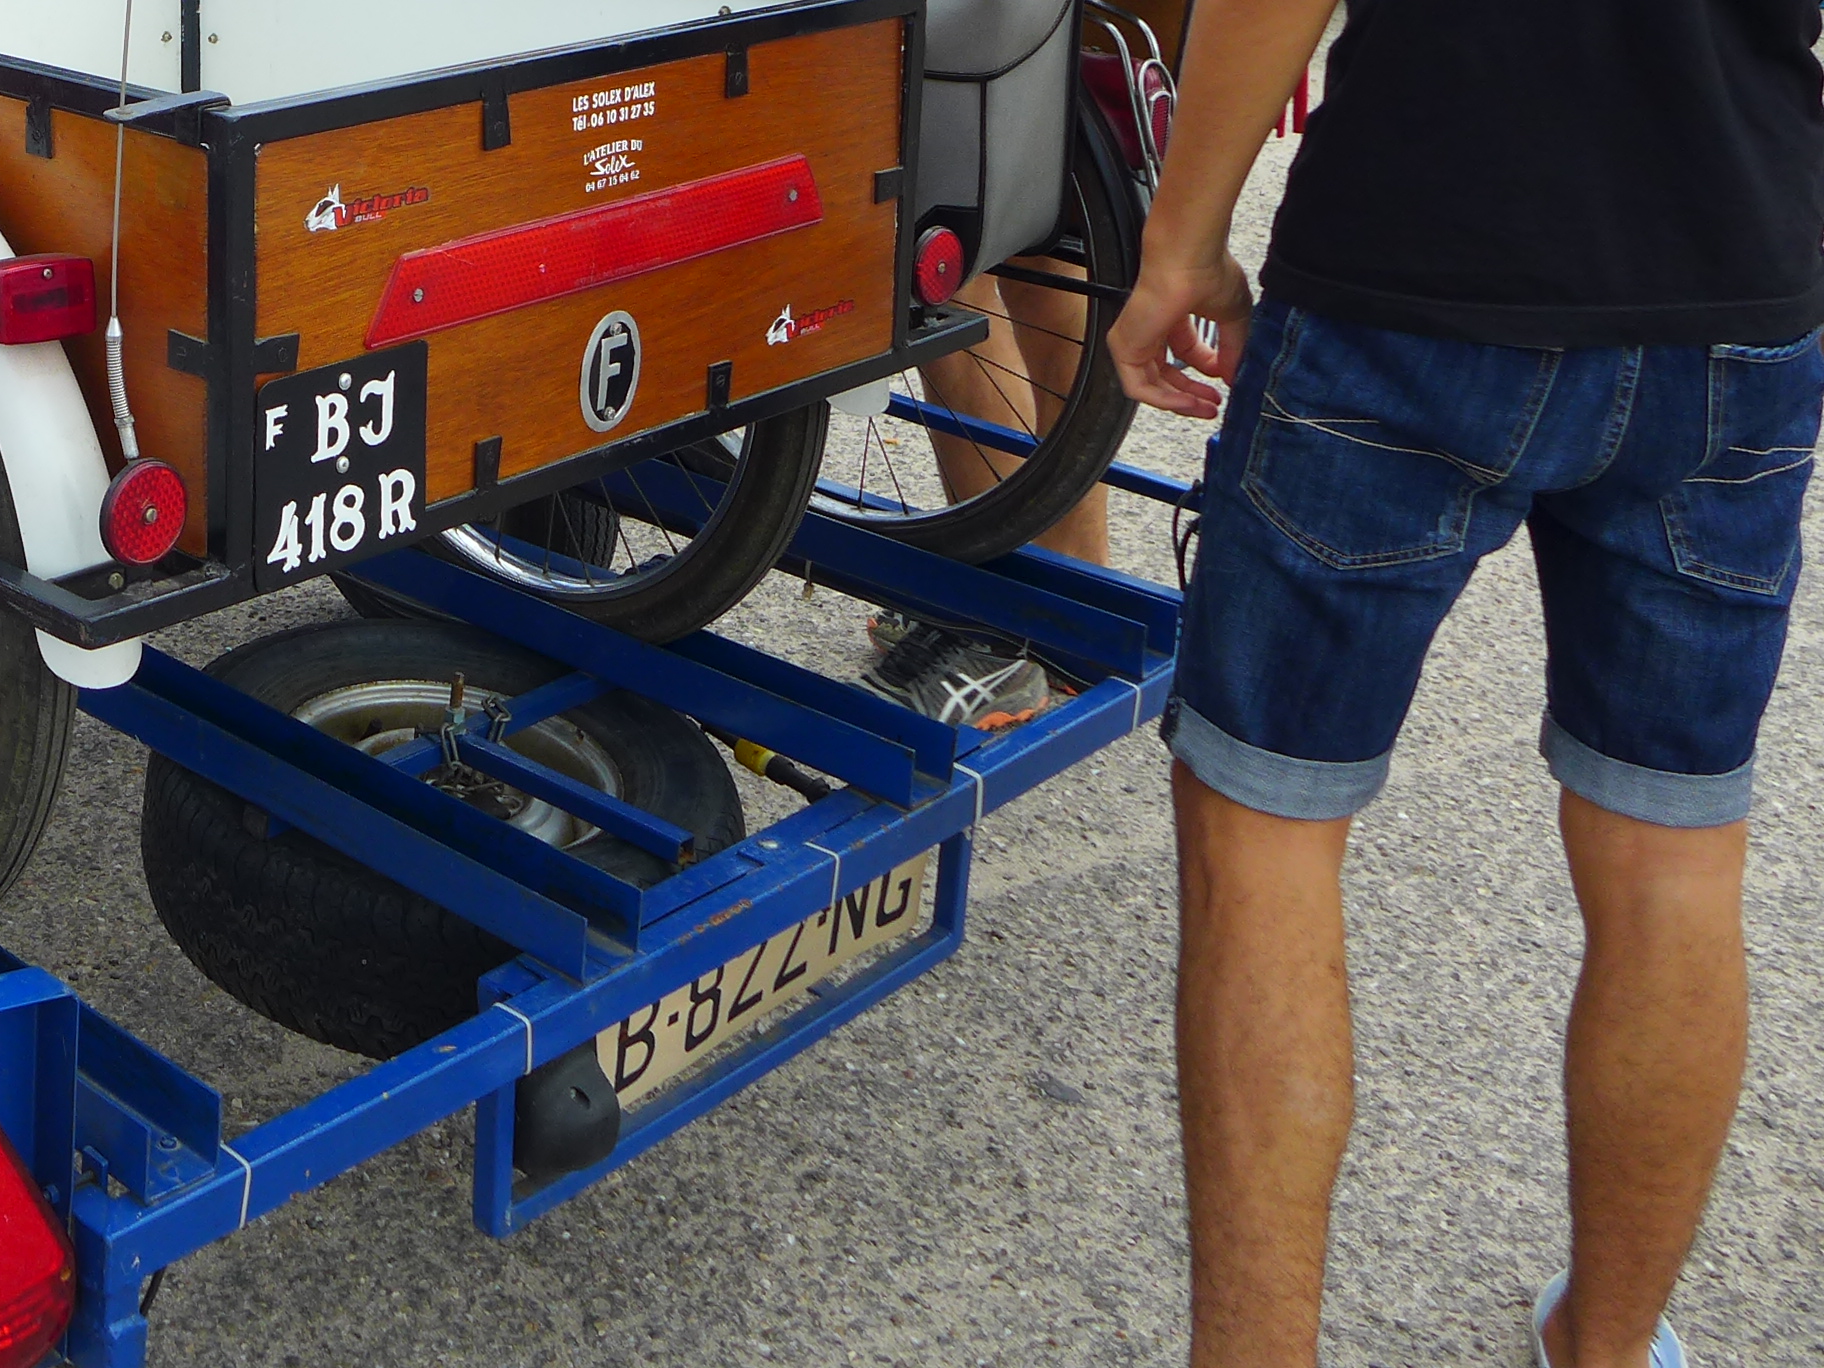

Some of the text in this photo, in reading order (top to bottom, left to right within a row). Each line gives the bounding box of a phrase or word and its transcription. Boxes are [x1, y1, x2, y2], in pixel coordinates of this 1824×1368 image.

[572, 80, 656, 113] LES SOLEX D'ALEX
[606, 109, 617, 124] 10
[619, 106, 629, 122] 31
[630, 103, 642, 120] 27
[643, 100, 656, 117] 35
[583, 139, 643, 166] L'ATELIER DU
[585, 180, 596, 193] 04
[597, 178, 607, 190] 67
[354, 212, 383, 223] BULL
[596, 332, 628, 412] F
[265, 404, 289, 451] F
